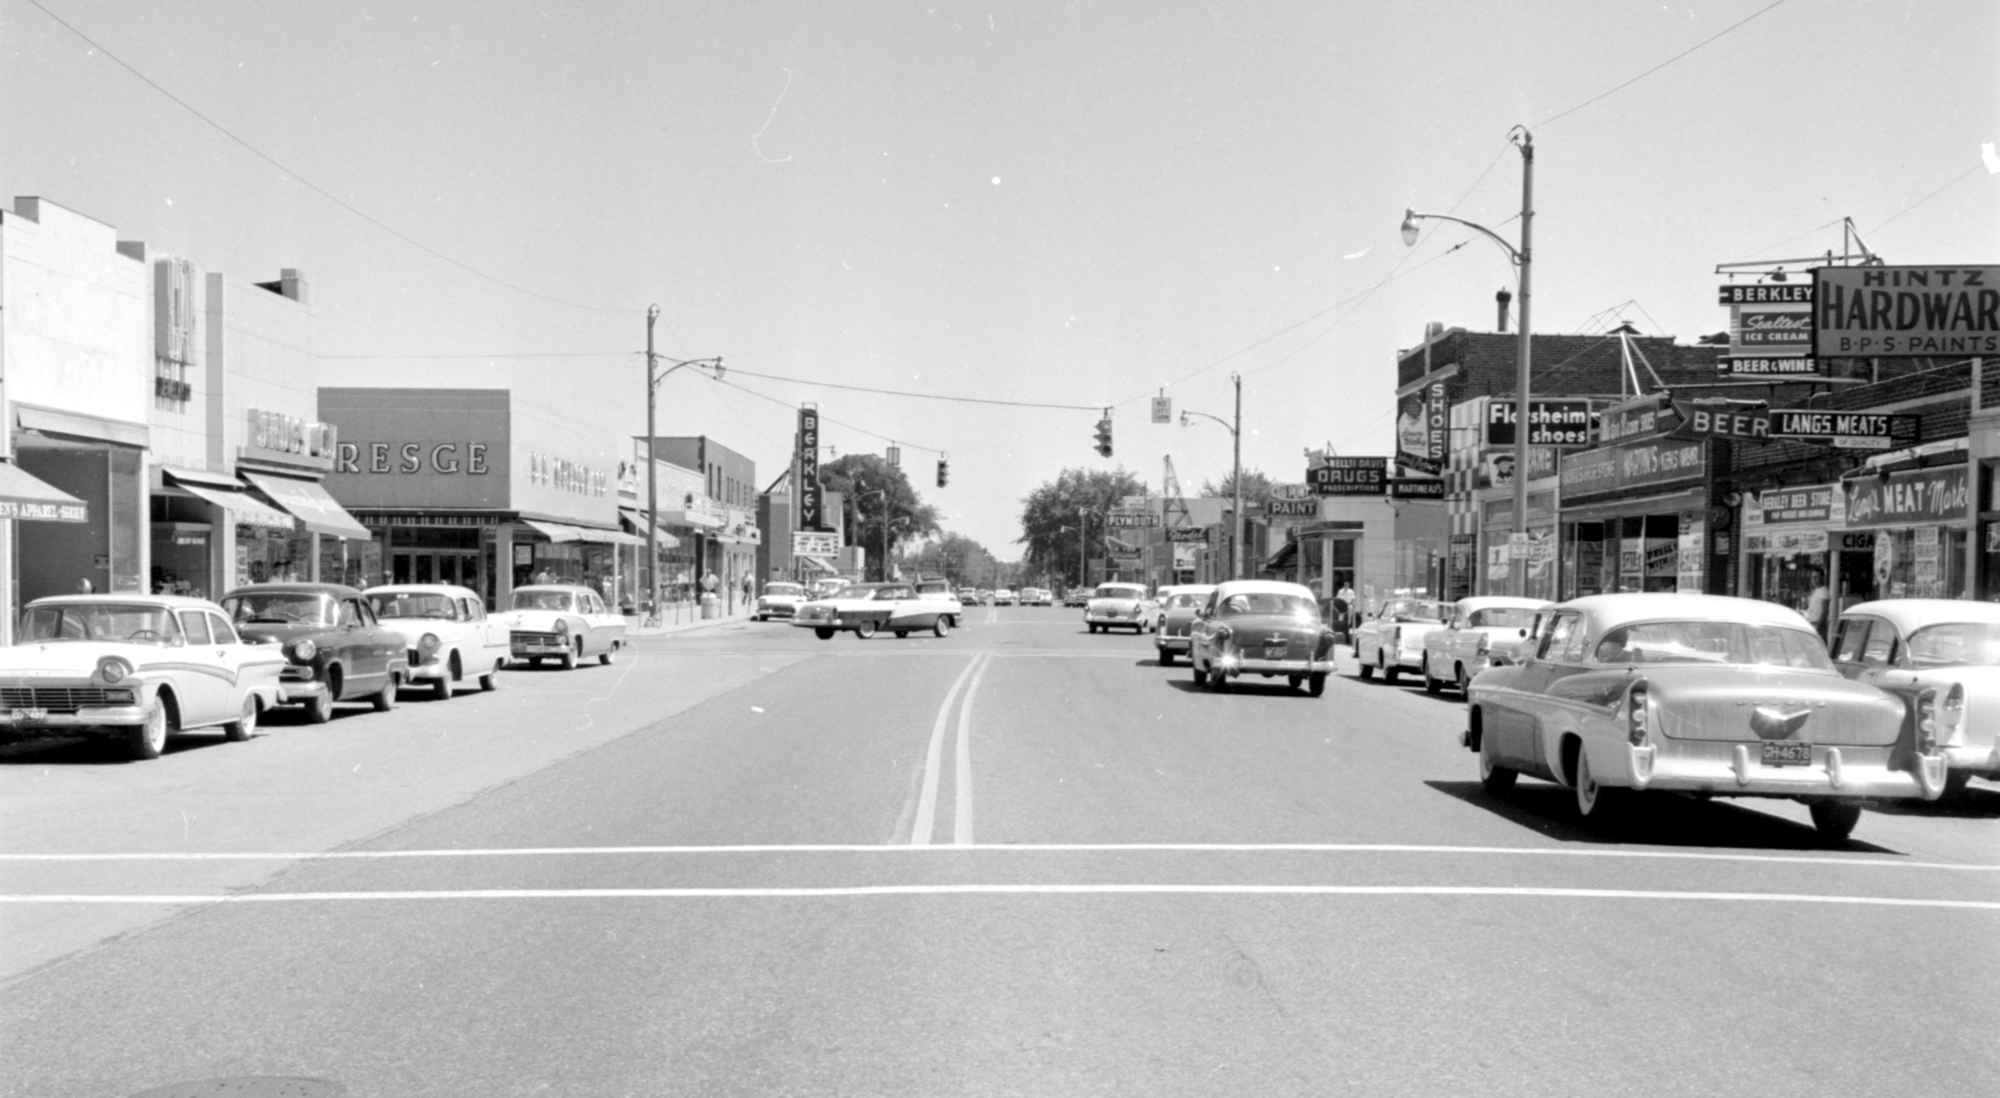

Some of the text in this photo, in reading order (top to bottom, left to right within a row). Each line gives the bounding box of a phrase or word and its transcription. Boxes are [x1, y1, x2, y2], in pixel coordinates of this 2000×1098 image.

[1863, 270, 1984, 287] HINTZ
[1734, 287, 1814, 301] BERKLEY
[1820, 280, 2000, 331] HARDWAR
[1746, 315, 1811, 330] Sealtest
[1745, 333, 1809, 341] ICE CREAM
[1909, 336, 1998, 351] PAINTS
[1733, 360, 1770, 372] BEER
[1779, 360, 1815, 372] WINE
[1431, 383, 1444, 459] SHOES
[1693, 411, 1769, 437] BEER
[1783, 414, 1887, 435] LANGS MEATS
[1532, 424, 1586, 443] shoes
[337, 441, 489, 475] RESGE
[1358, 459, 1386, 468] DAVIS
[803, 416, 815, 521] BERKLEY
[1318, 469, 1380, 483] DRUGS
[1323, 484, 1380, 492] PRESCRIPTIONS
[1398, 484, 1443, 494] MARTINEAU'S
[1763, 495, 1789, 510] BERKLEY
[1791, 493, 1807, 508] BEER
[1811, 491, 1831, 507] STORE
[1848, 486, 1880, 521] Lang's
[1883, 482, 1925, 514] MEAT
[1272, 502, 1316, 515] PAINT
[1109, 515, 1159, 527] PLYMOUTH
